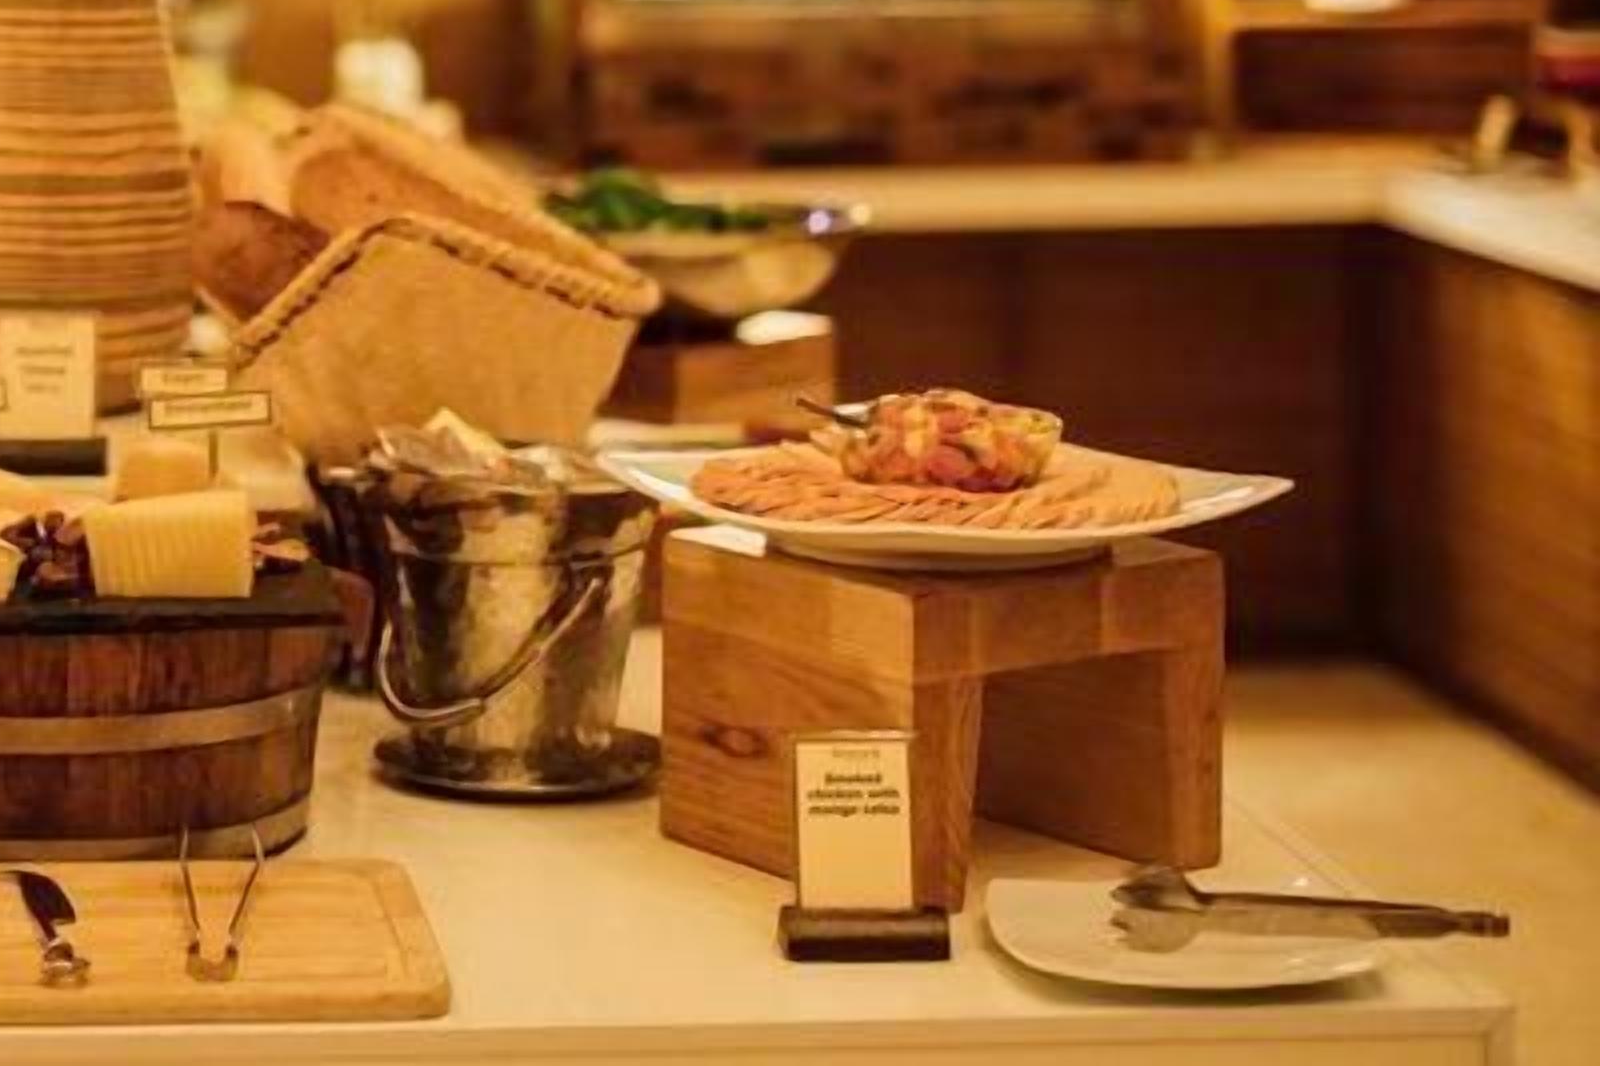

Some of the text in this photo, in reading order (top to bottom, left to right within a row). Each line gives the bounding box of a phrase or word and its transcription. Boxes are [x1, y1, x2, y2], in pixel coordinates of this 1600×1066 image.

[824, 772, 882, 785] Smoked
[807, 787, 900, 800] chicken with
[808, 805, 857, 818] mango
